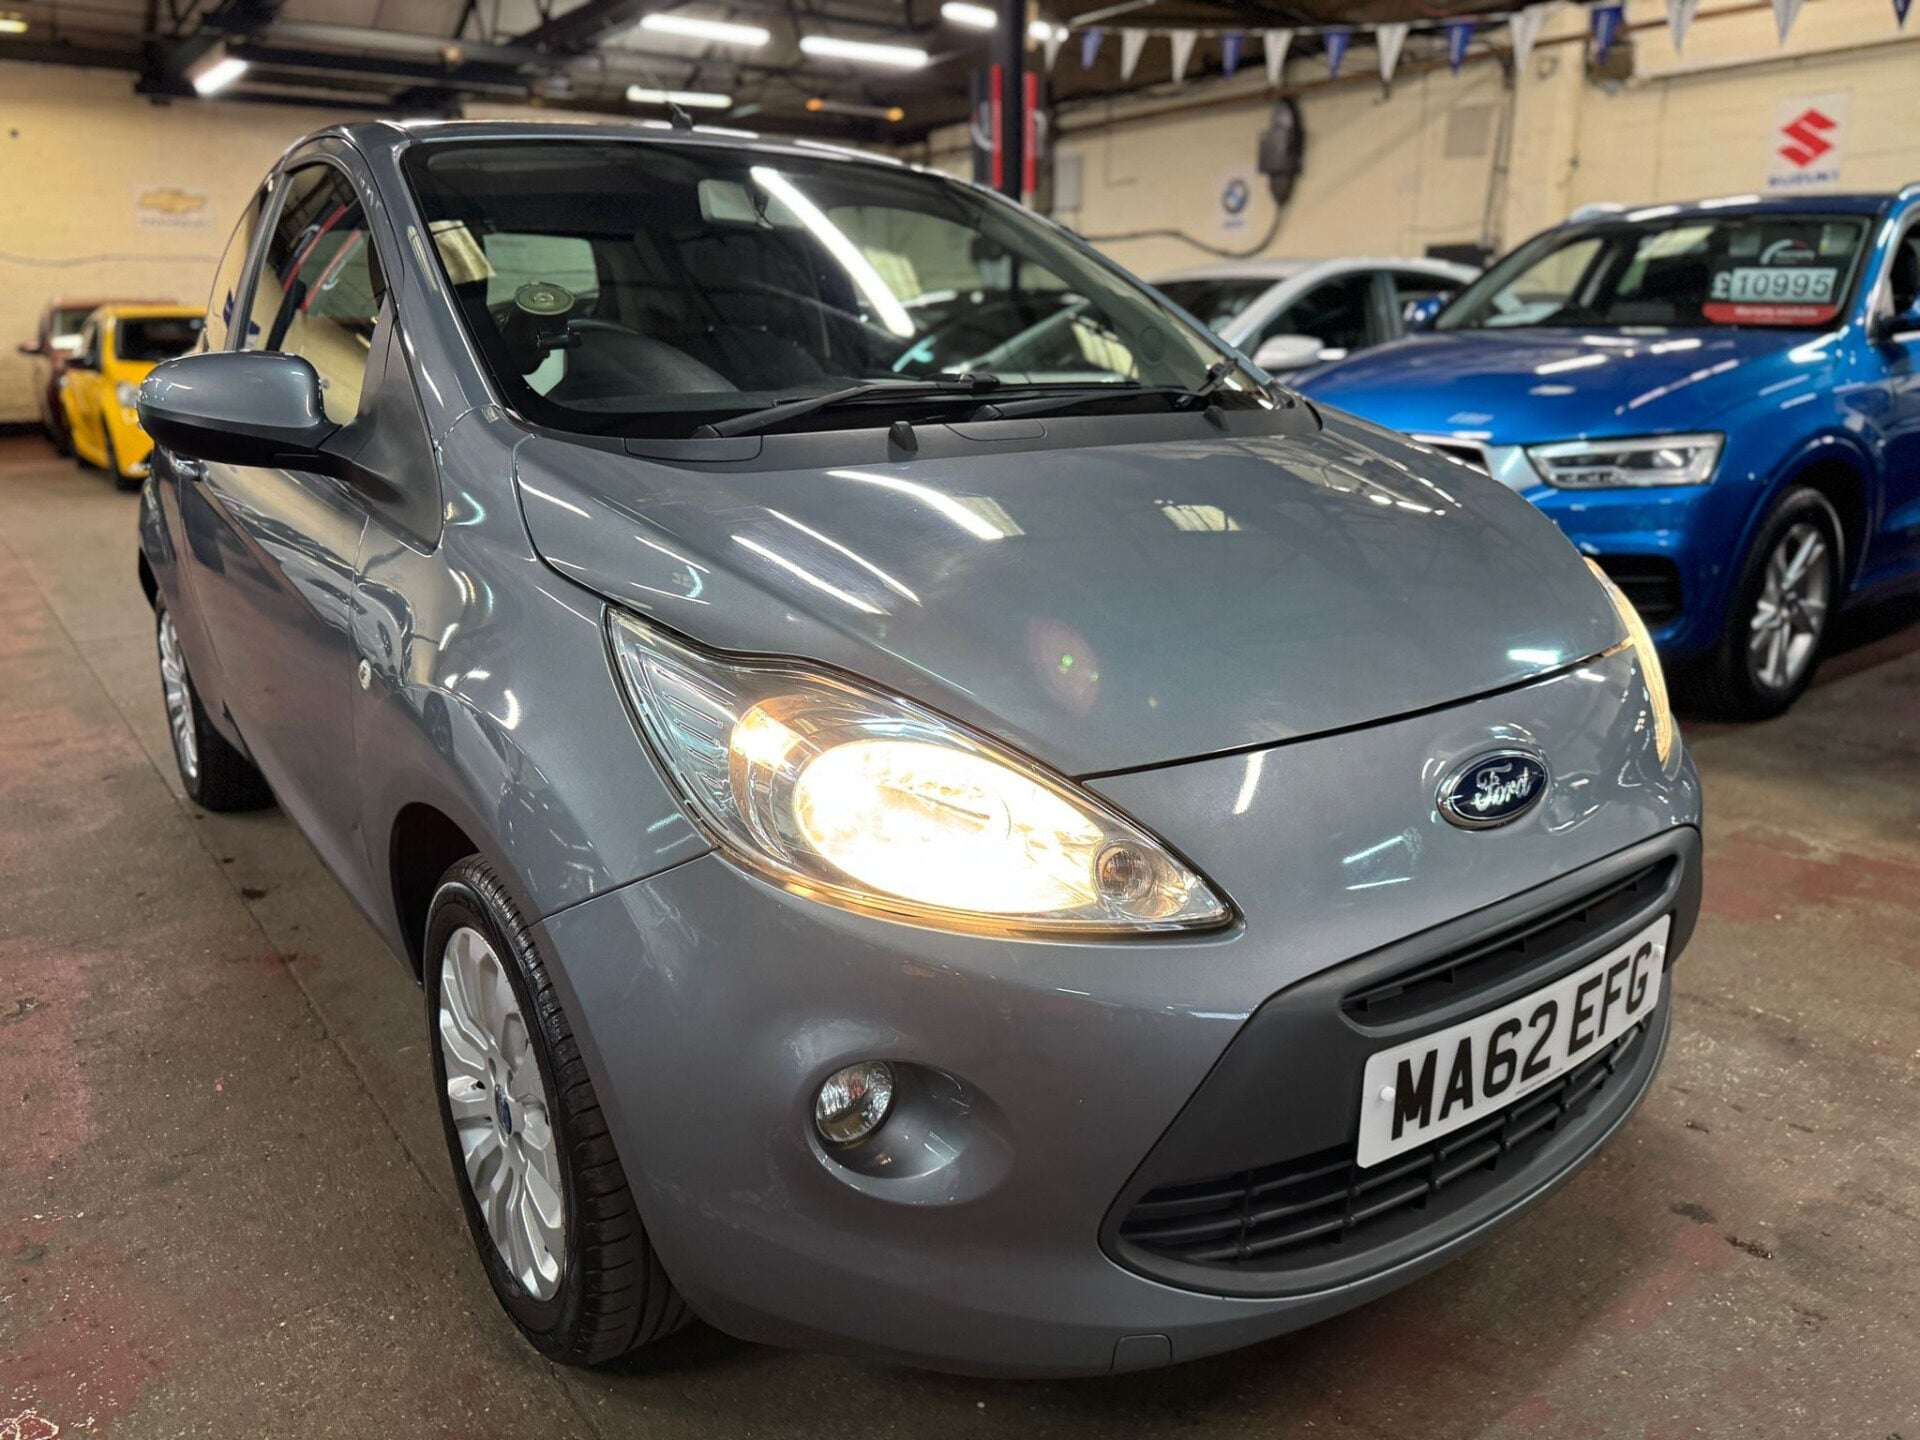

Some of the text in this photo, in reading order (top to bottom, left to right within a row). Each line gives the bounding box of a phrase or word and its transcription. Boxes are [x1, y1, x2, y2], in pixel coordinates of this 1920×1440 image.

[1470, 762, 1532, 812] Ford
[1391, 941, 1653, 1141] MA62 EFG
